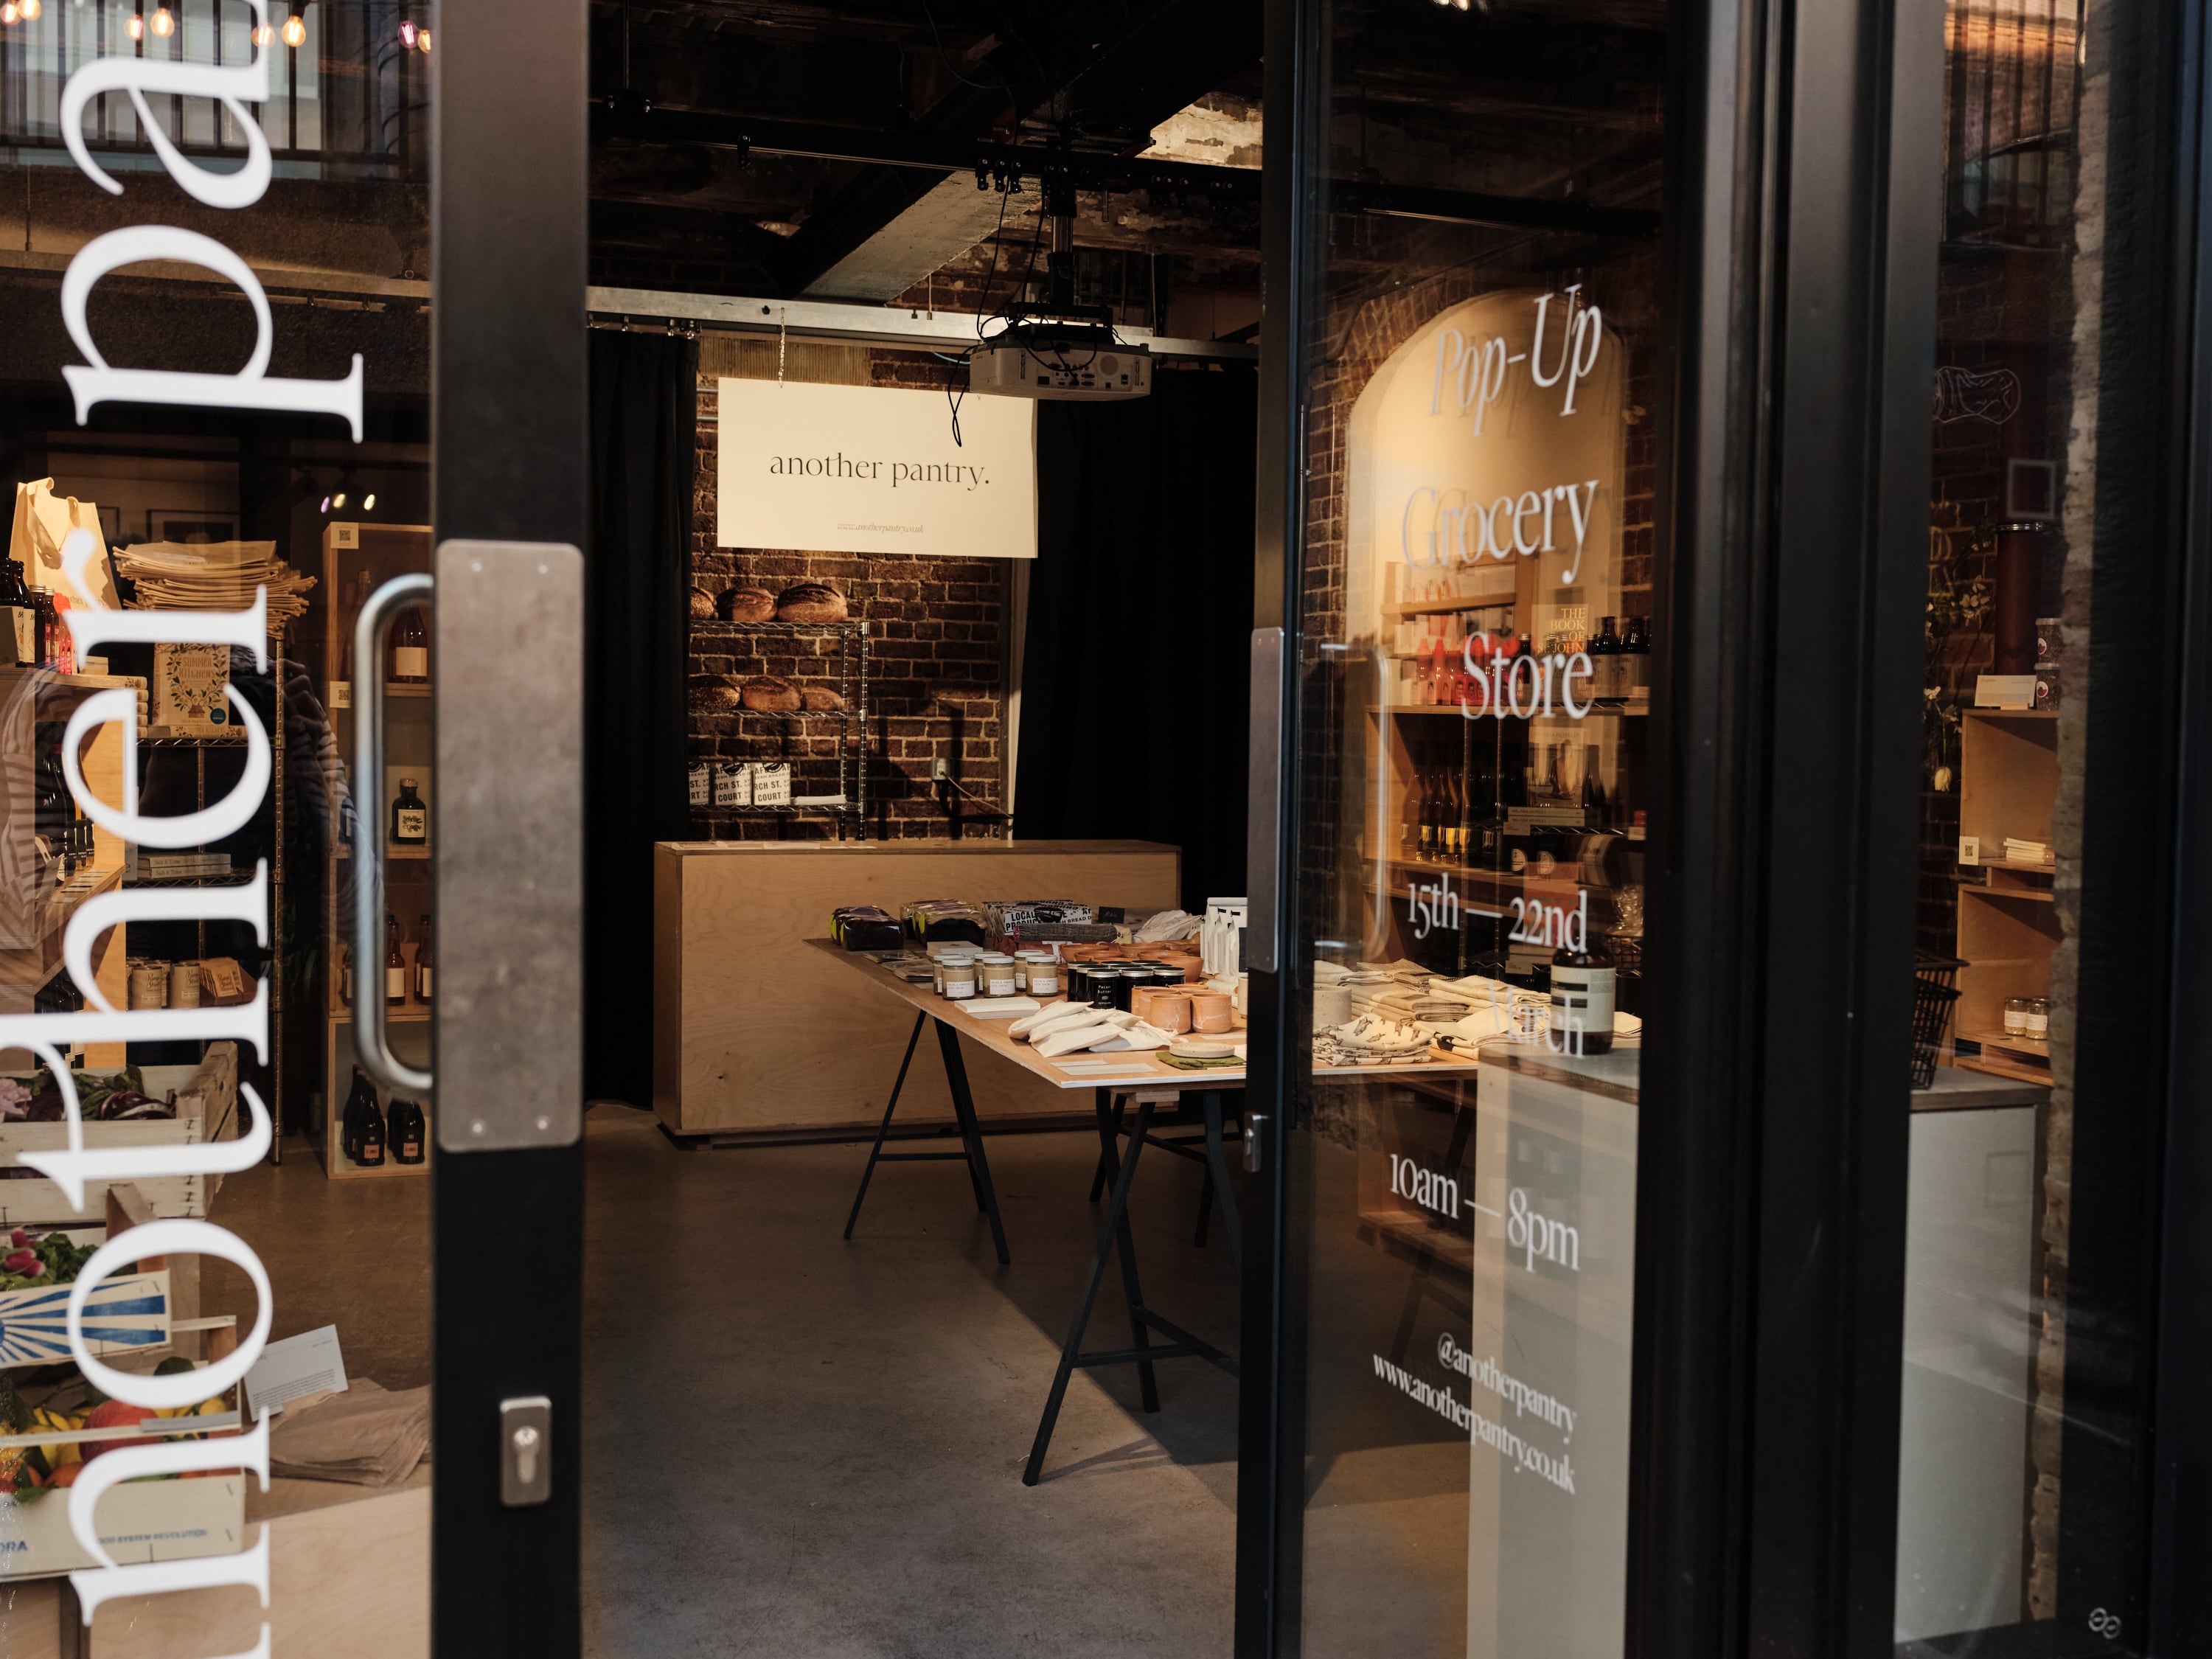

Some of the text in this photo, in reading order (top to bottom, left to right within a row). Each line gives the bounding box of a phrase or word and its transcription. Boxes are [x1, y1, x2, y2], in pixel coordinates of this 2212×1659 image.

[1429, 283, 1602, 437] Pop-Up
[770, 452, 990, 491] another pantry.
[1402, 479, 1600, 585] Grocery
[1561, 608, 1586, 619] THE
[1551, 619, 1585, 630] BOOK
[1553, 642, 1585, 654] JOHN
[182, 656, 212, 667] SUMMER
[179, 667, 215, 678] KITCHENS
[1461, 630, 1594, 720] Store
[731, 780, 742, 789] ST.
[771, 780, 782, 788] ST.
[717, 792, 742, 802] COURT
[757, 792, 782, 802] COURT
[0, 0, 364, 1659] nother pa
[1011, 911, 1036, 922] LOCAL
[1408, 872, 1460, 940] 15th
[1508, 889, 1588, 954] 22nd
[1486, 979, 1585, 1060] March
[1390, 1153, 1459, 1220] 10am
[1507, 1186, 1581, 1273] 8pm
[1438, 1332, 1578, 1445] @anotherpantry
[1373, 1353, 1576, 1495] www.anotherpantry.co.uk
[117, 1534, 152, 1543] SYSTEM
[153, 1528, 208, 1540] REVOLUTION
